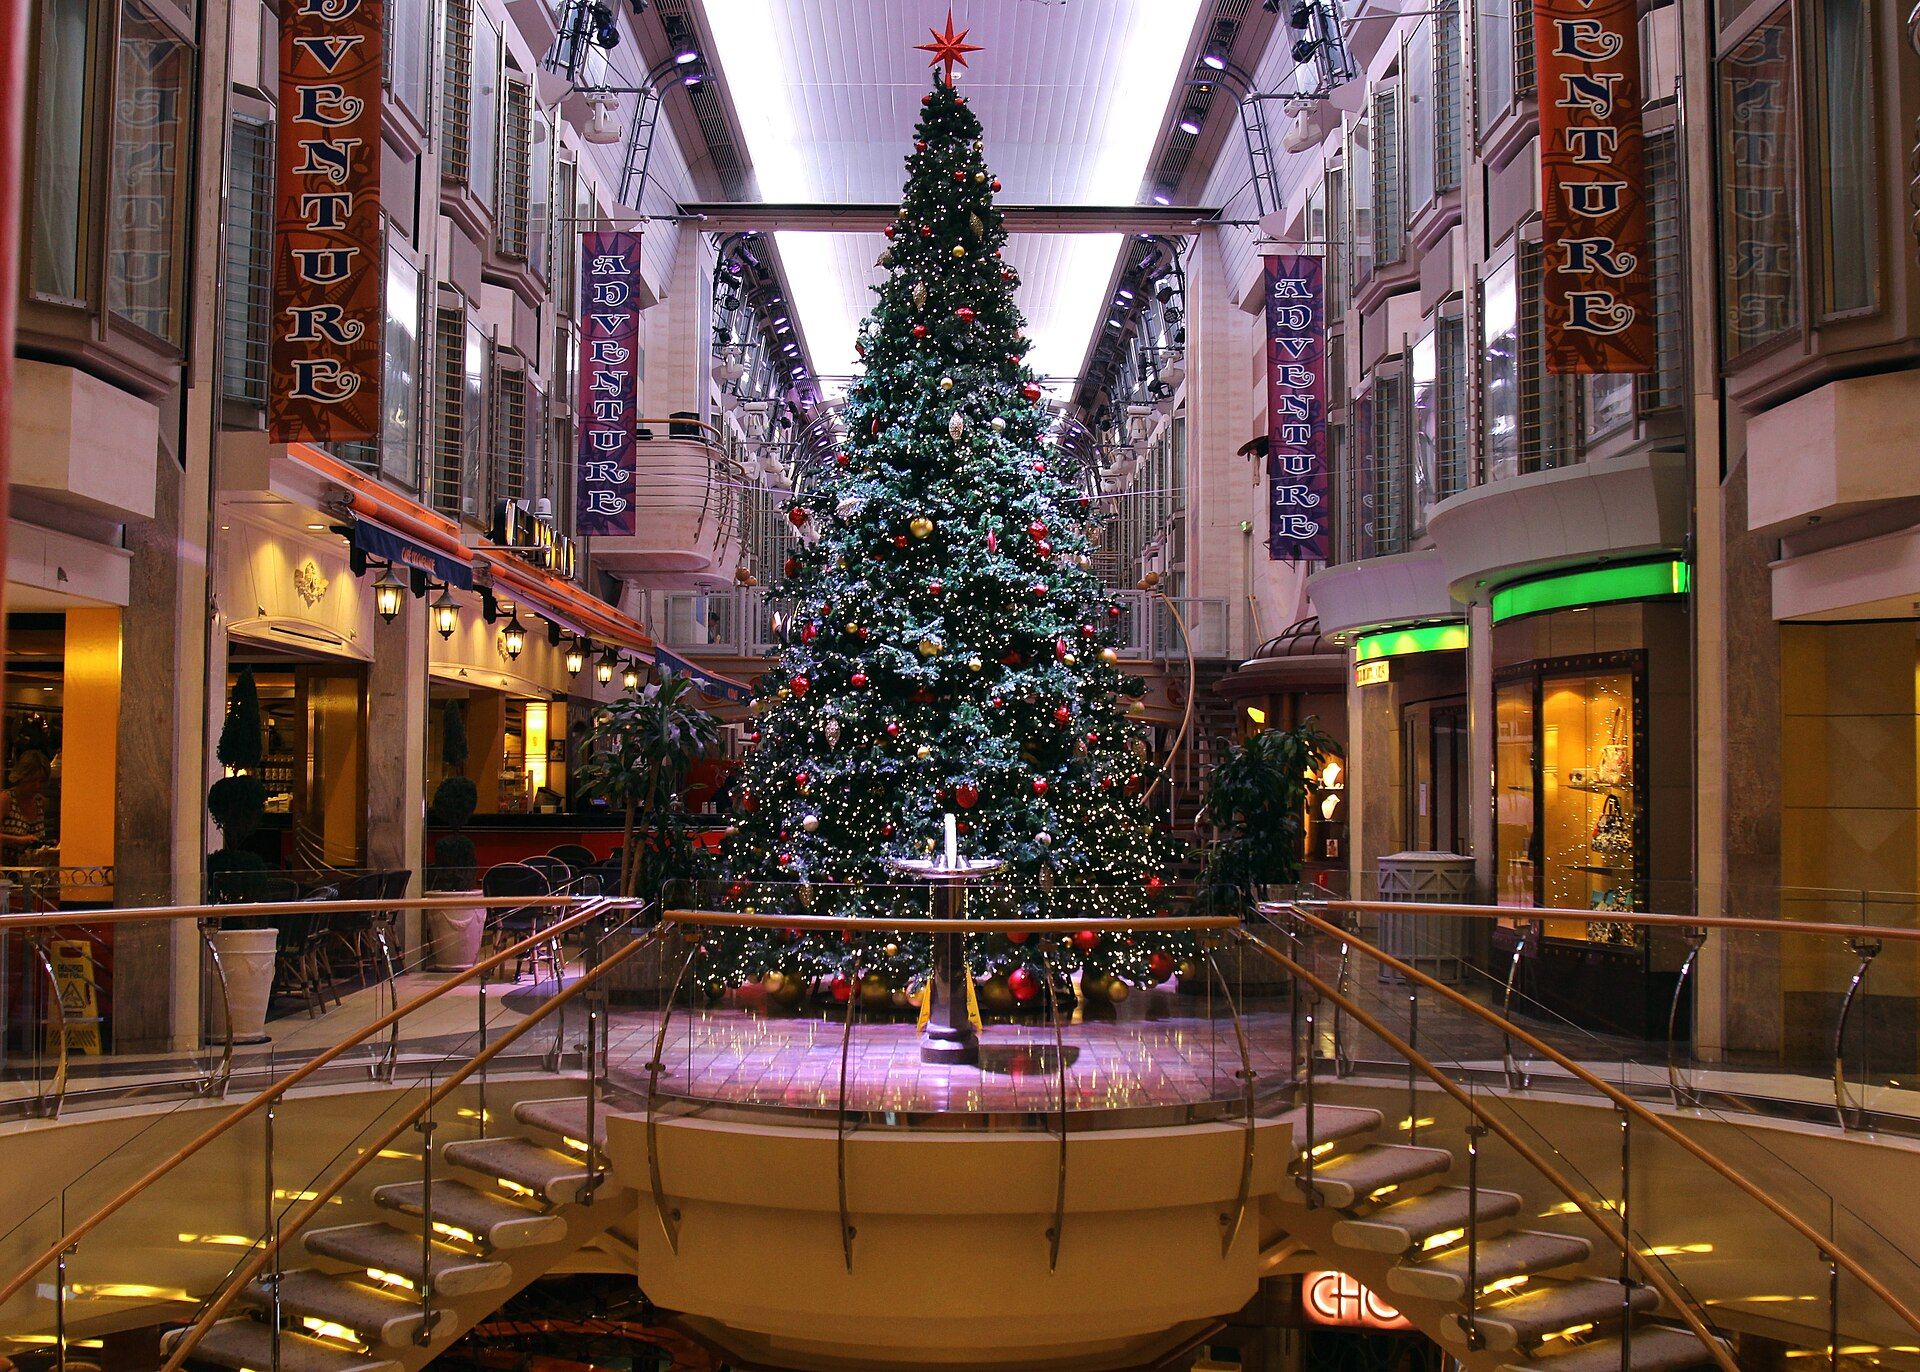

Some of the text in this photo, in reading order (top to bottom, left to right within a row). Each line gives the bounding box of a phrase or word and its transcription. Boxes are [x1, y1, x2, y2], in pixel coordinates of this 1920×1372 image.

[1552, 0, 1638, 336] ENTURE
[586, 254, 631, 515] ADVENTURE
[1274, 277, 1320, 540] ADVENTURE
